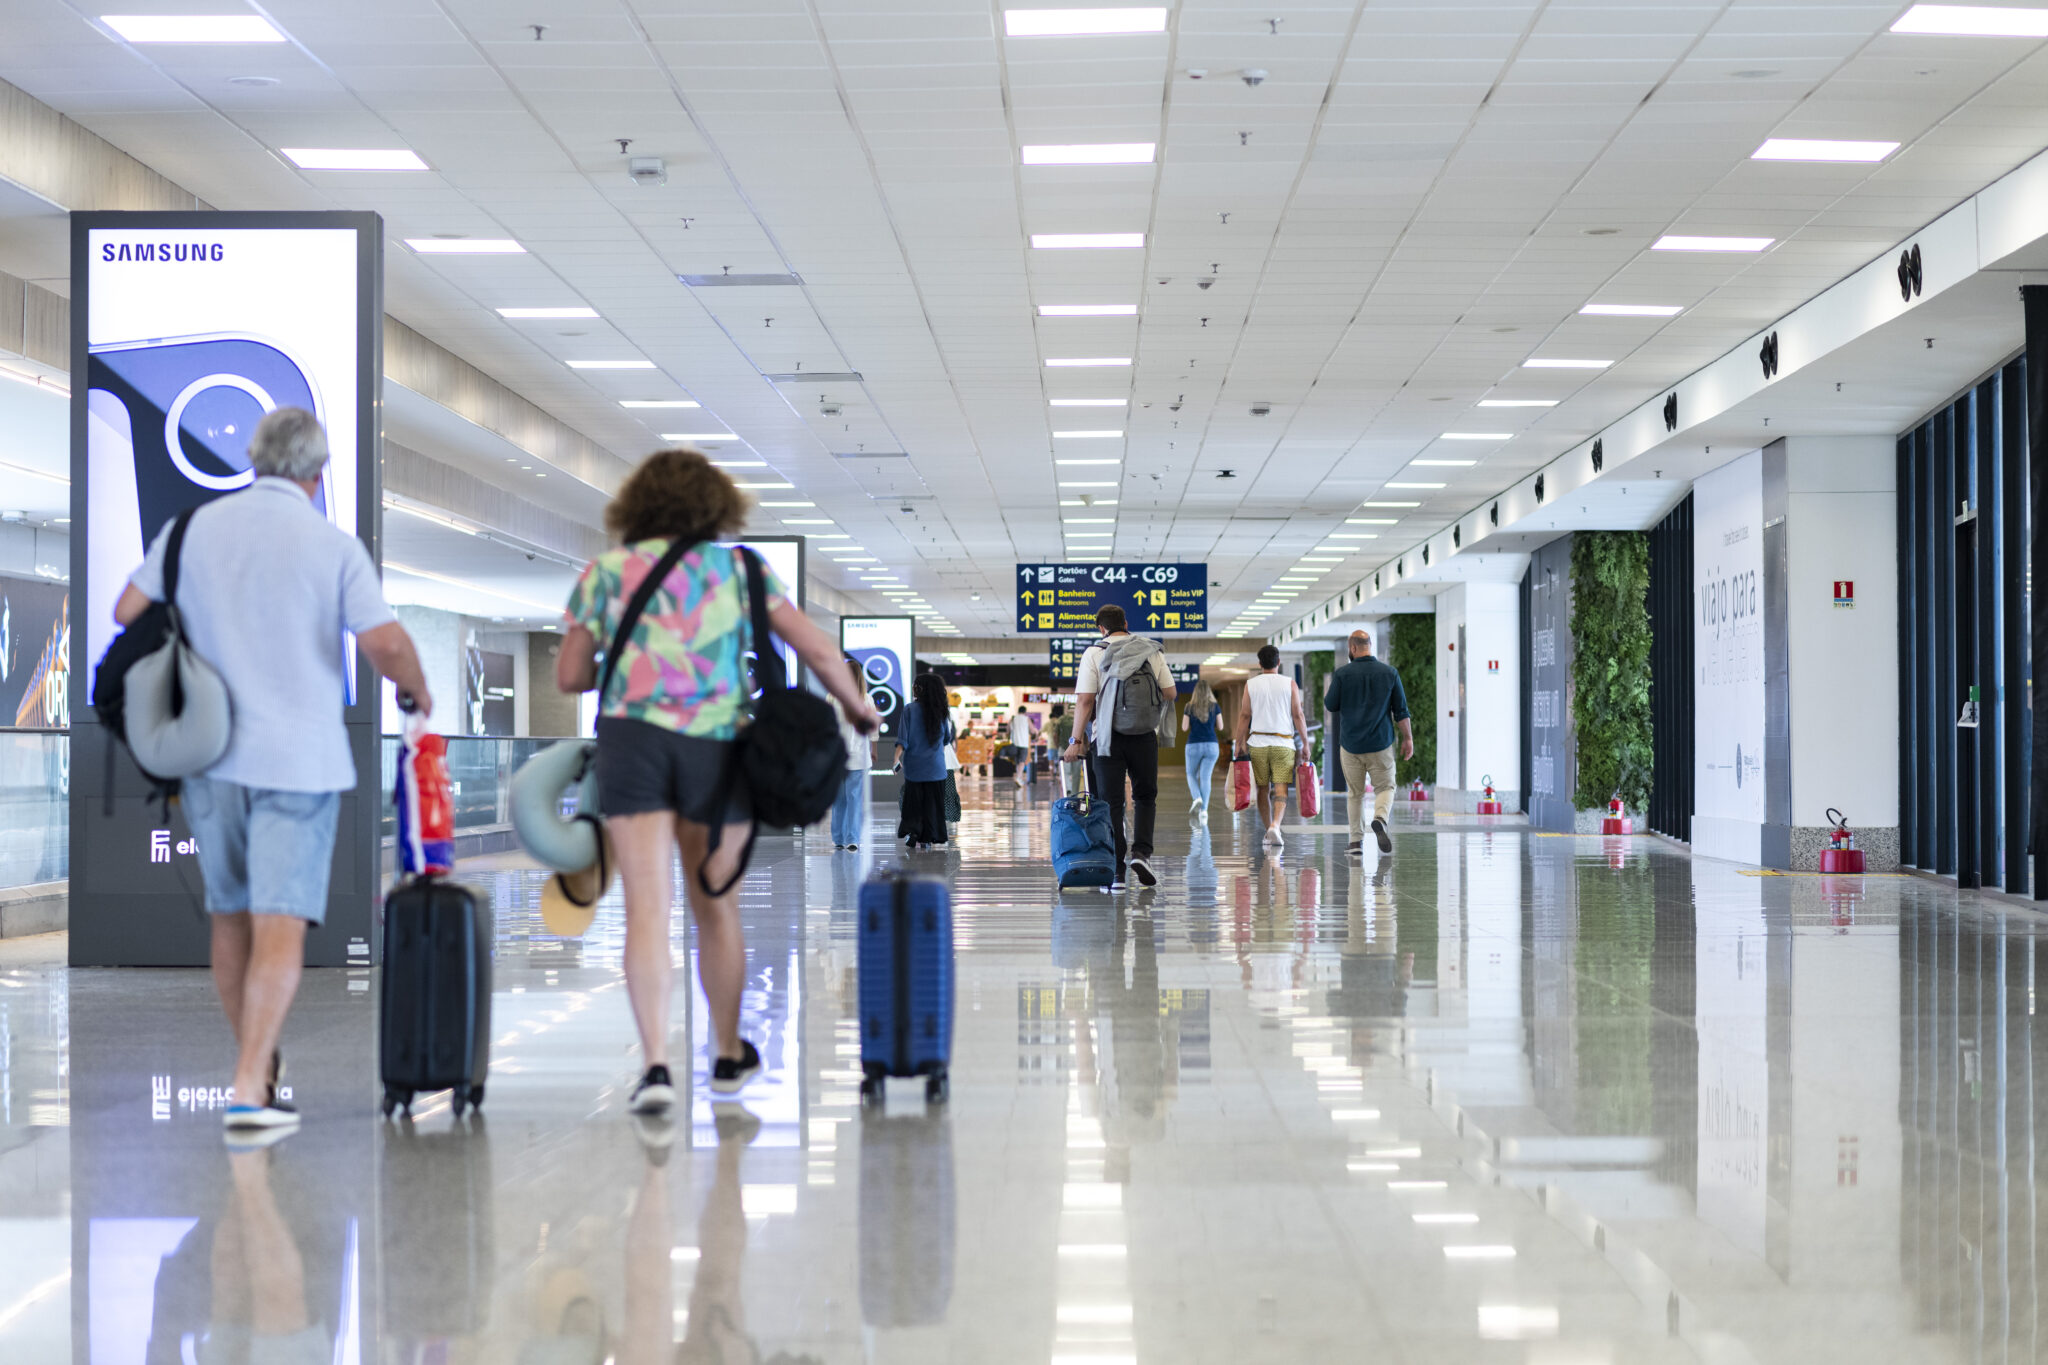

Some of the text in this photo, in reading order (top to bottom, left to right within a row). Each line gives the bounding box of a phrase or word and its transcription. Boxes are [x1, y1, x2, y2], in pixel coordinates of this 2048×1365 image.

[102, 243, 224, 262] SAMSUNG
[1058, 567, 1088, 575] Portões
[1091, 567, 1127, 583] C44
[1142, 567, 1178, 583] C69
[1170, 589, 1204, 597] Salas VIP
[1702, 565, 1756, 640] viajo para
[1058, 612, 1097, 621] Alimentaç
[1184, 613, 1204, 621] Lojas
